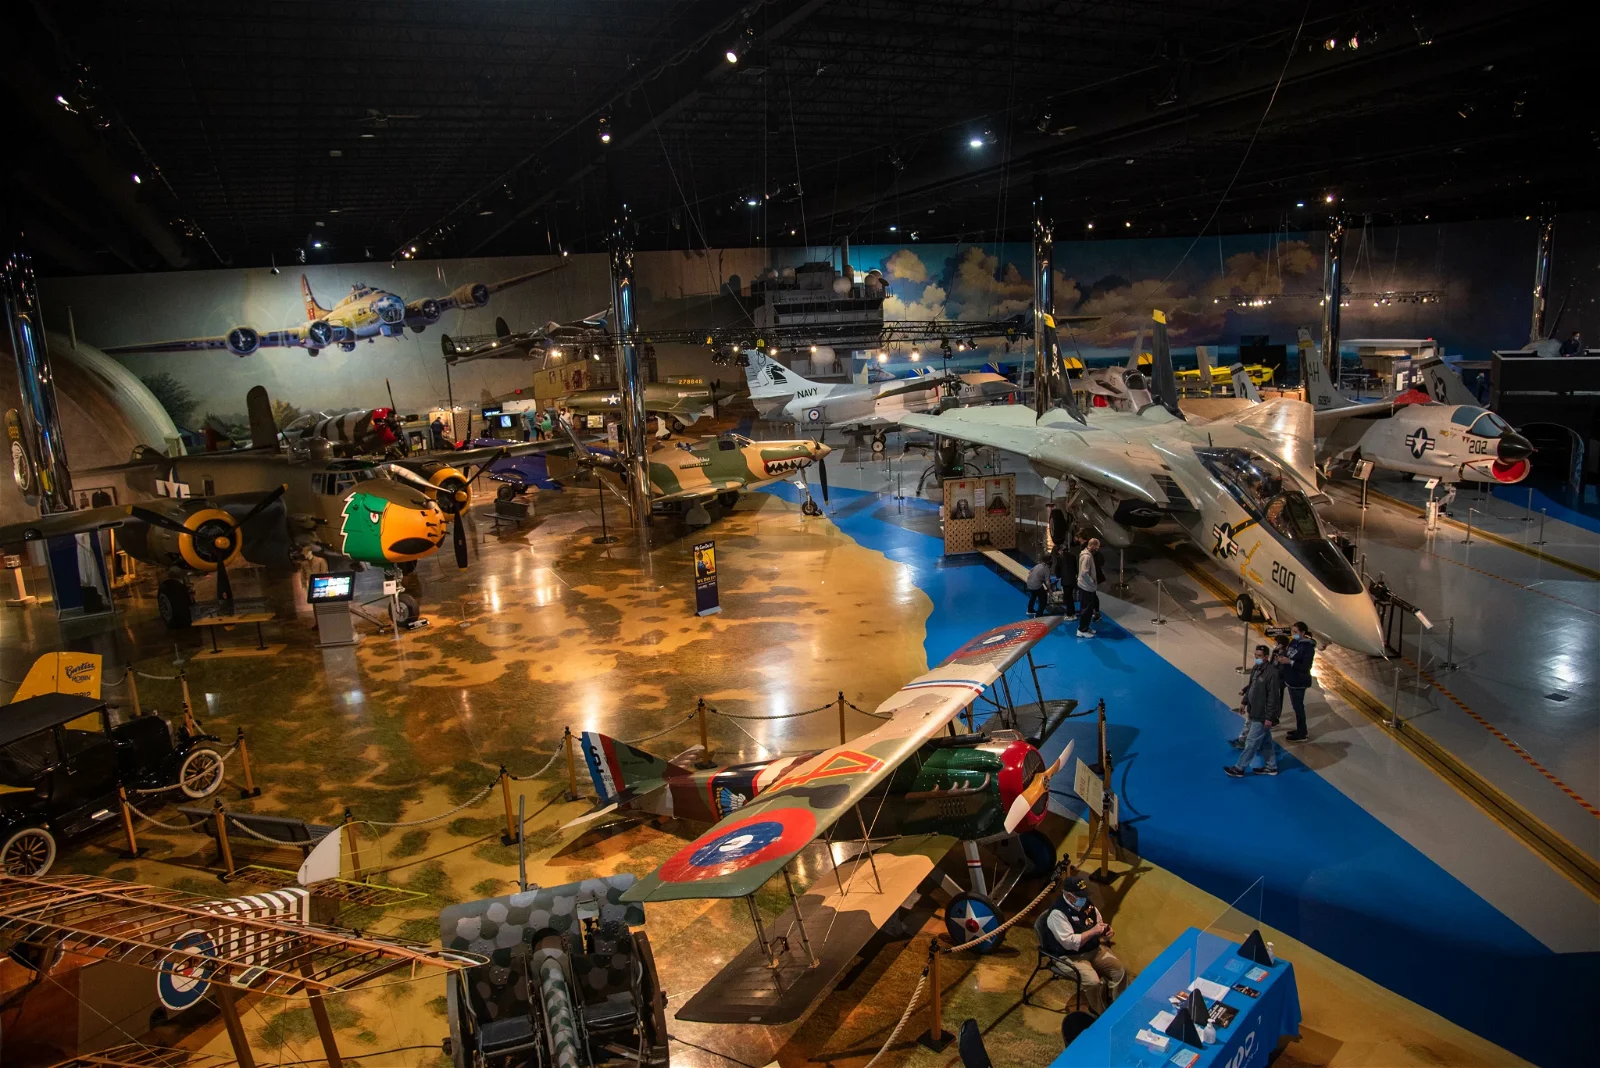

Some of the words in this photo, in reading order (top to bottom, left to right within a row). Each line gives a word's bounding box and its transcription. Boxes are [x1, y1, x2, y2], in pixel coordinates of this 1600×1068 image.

[797, 388, 818, 399] NAVY
[1469, 440, 1488, 454] 202
[1272, 560, 1296, 594] 200
[65, 661, 95, 678] Curtiss
[72, 675, 91, 683] ROBIN
